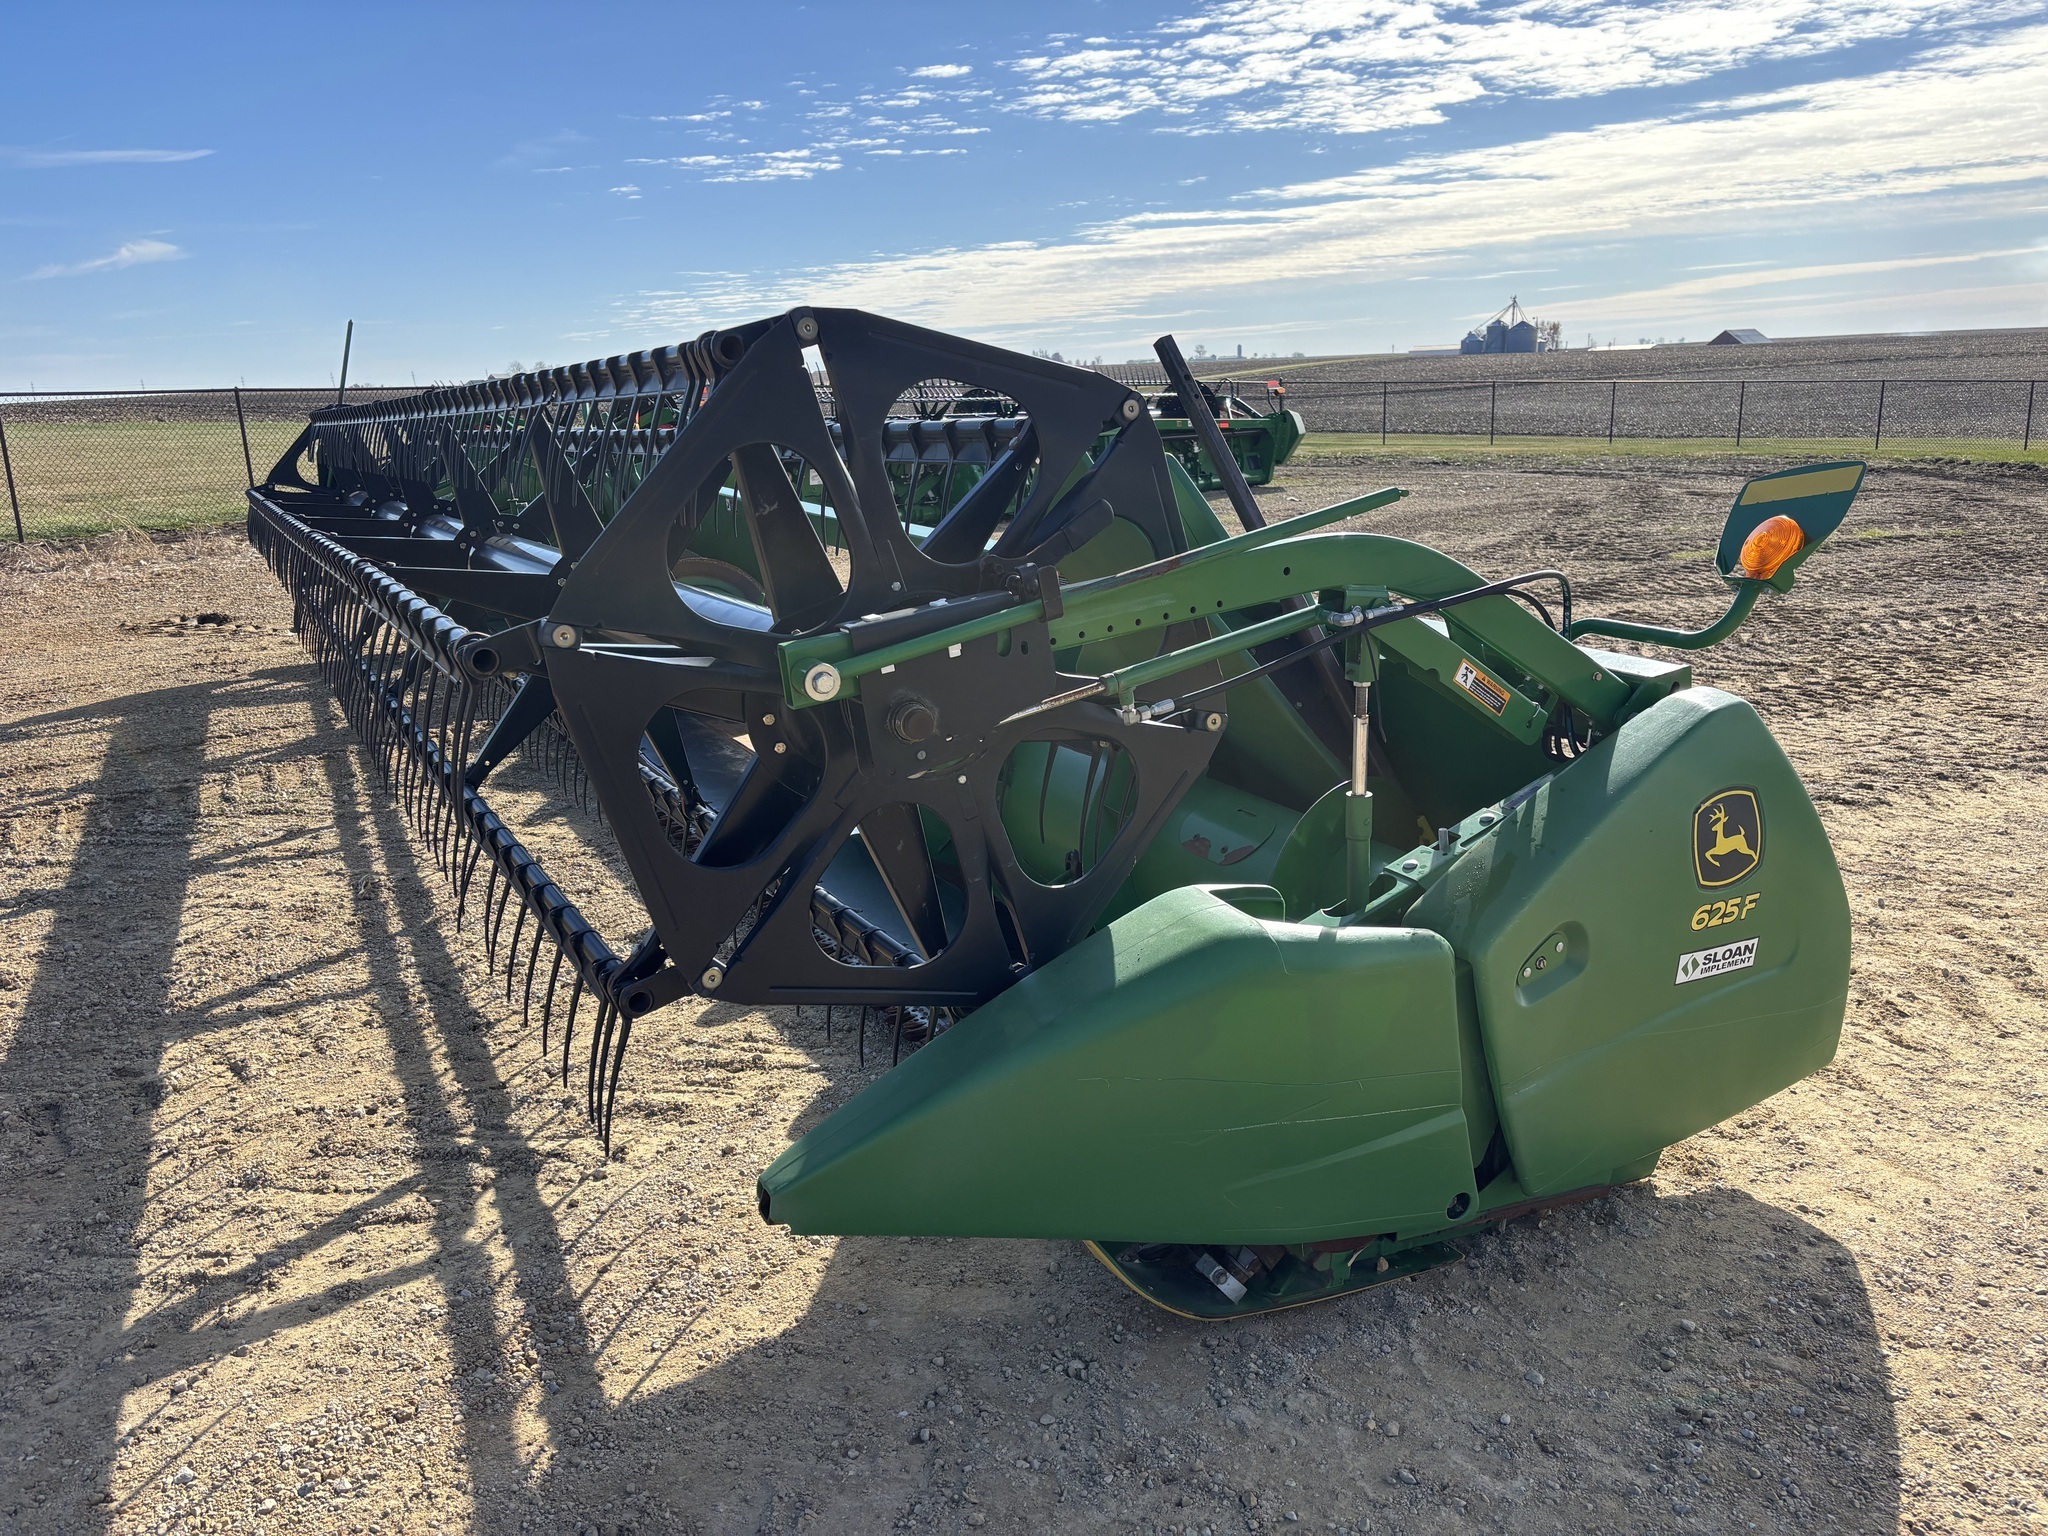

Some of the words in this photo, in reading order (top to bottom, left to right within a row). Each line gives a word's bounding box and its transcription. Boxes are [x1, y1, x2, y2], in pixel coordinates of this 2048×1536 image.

[1486, 678, 1505, 696] WARNING
[1691, 892, 1761, 931] 625F
[1702, 943, 1755, 966] SLOAN
[1700, 956, 1753, 975] IMPLEMENT
